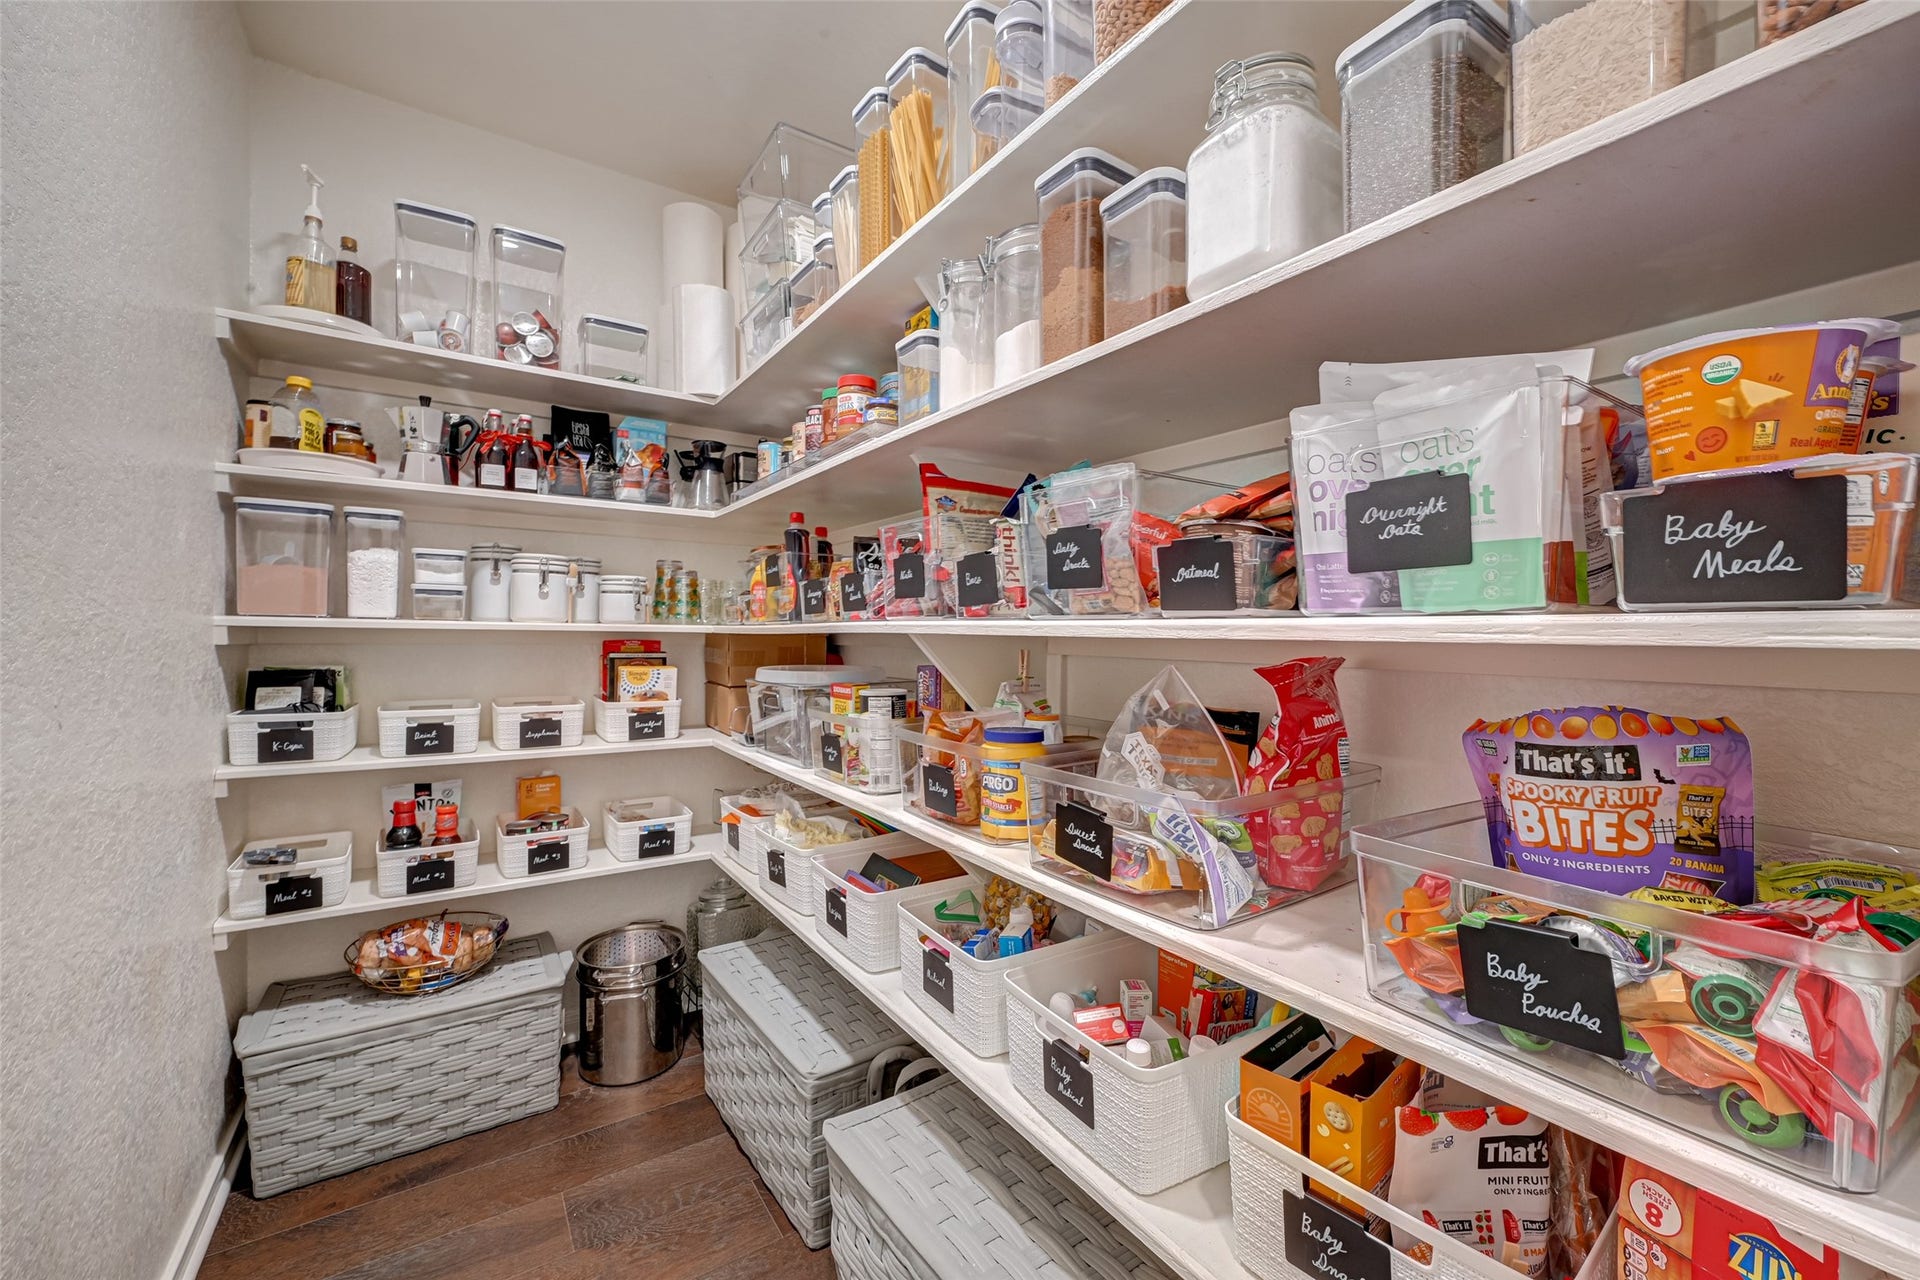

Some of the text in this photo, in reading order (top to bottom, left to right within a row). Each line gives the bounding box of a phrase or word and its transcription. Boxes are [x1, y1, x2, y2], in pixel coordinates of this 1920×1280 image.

[1709, 360, 1733, 371] USDA
[1811, 383, 1852, 401] Anni
[1401, 428, 1478, 464] oats
[1790, 436, 1813, 448] Real
[1306, 449, 1378, 476] oats
[1360, 495, 1448, 524] Overnight
[1664, 510, 1768, 548] Baby
[1002, 526, 1020, 583] think!
[1053, 541, 1080, 558] Salty
[1693, 540, 1803, 579] Meals
[1063, 557, 1091, 572] Snacks
[1171, 562, 1220, 583] Oatmeal
[1313, 713, 1341, 729] Anima
[272, 740, 305, 753] K-Cups
[1520, 748, 1594, 774] That's
[982, 774, 1014, 791] ARGO
[1507, 778, 1661, 806] SPOOKY FRUIT
[1682, 806, 1713, 818] BITES
[1065, 822, 1097, 843] Sweet
[1511, 799, 1652, 854] BITES
[1073, 838, 1104, 860] Snacks
[1522, 852, 1651, 875] ONLY 2 INGREDIENTS
[1669, 856, 1725, 875] 20 BANANA
[412, 873, 431, 885] Meal
[273, 890, 297, 905] Meal
[1652, 893, 1685, 903] BAKED
[1487, 951, 1549, 991] Baby
[1521, 992, 1603, 1034] Pouches
[1050, 1055, 1073, 1085] Baby
[1057, 1081, 1084, 1108] Medical
[1487, 1175, 1549, 1186] MINI FRUIT
[1493, 1188, 1516, 1196] ONLY
[1641, 1190, 1671, 1210] FRESH
[1645, 1202, 1663, 1228] 8
[1301, 1212, 1347, 1256] Baby
[1443, 1221, 1463, 1231] That's
[1523, 1221, 1544, 1230] That's
[1530, 1248, 1547, 1256] MAN
